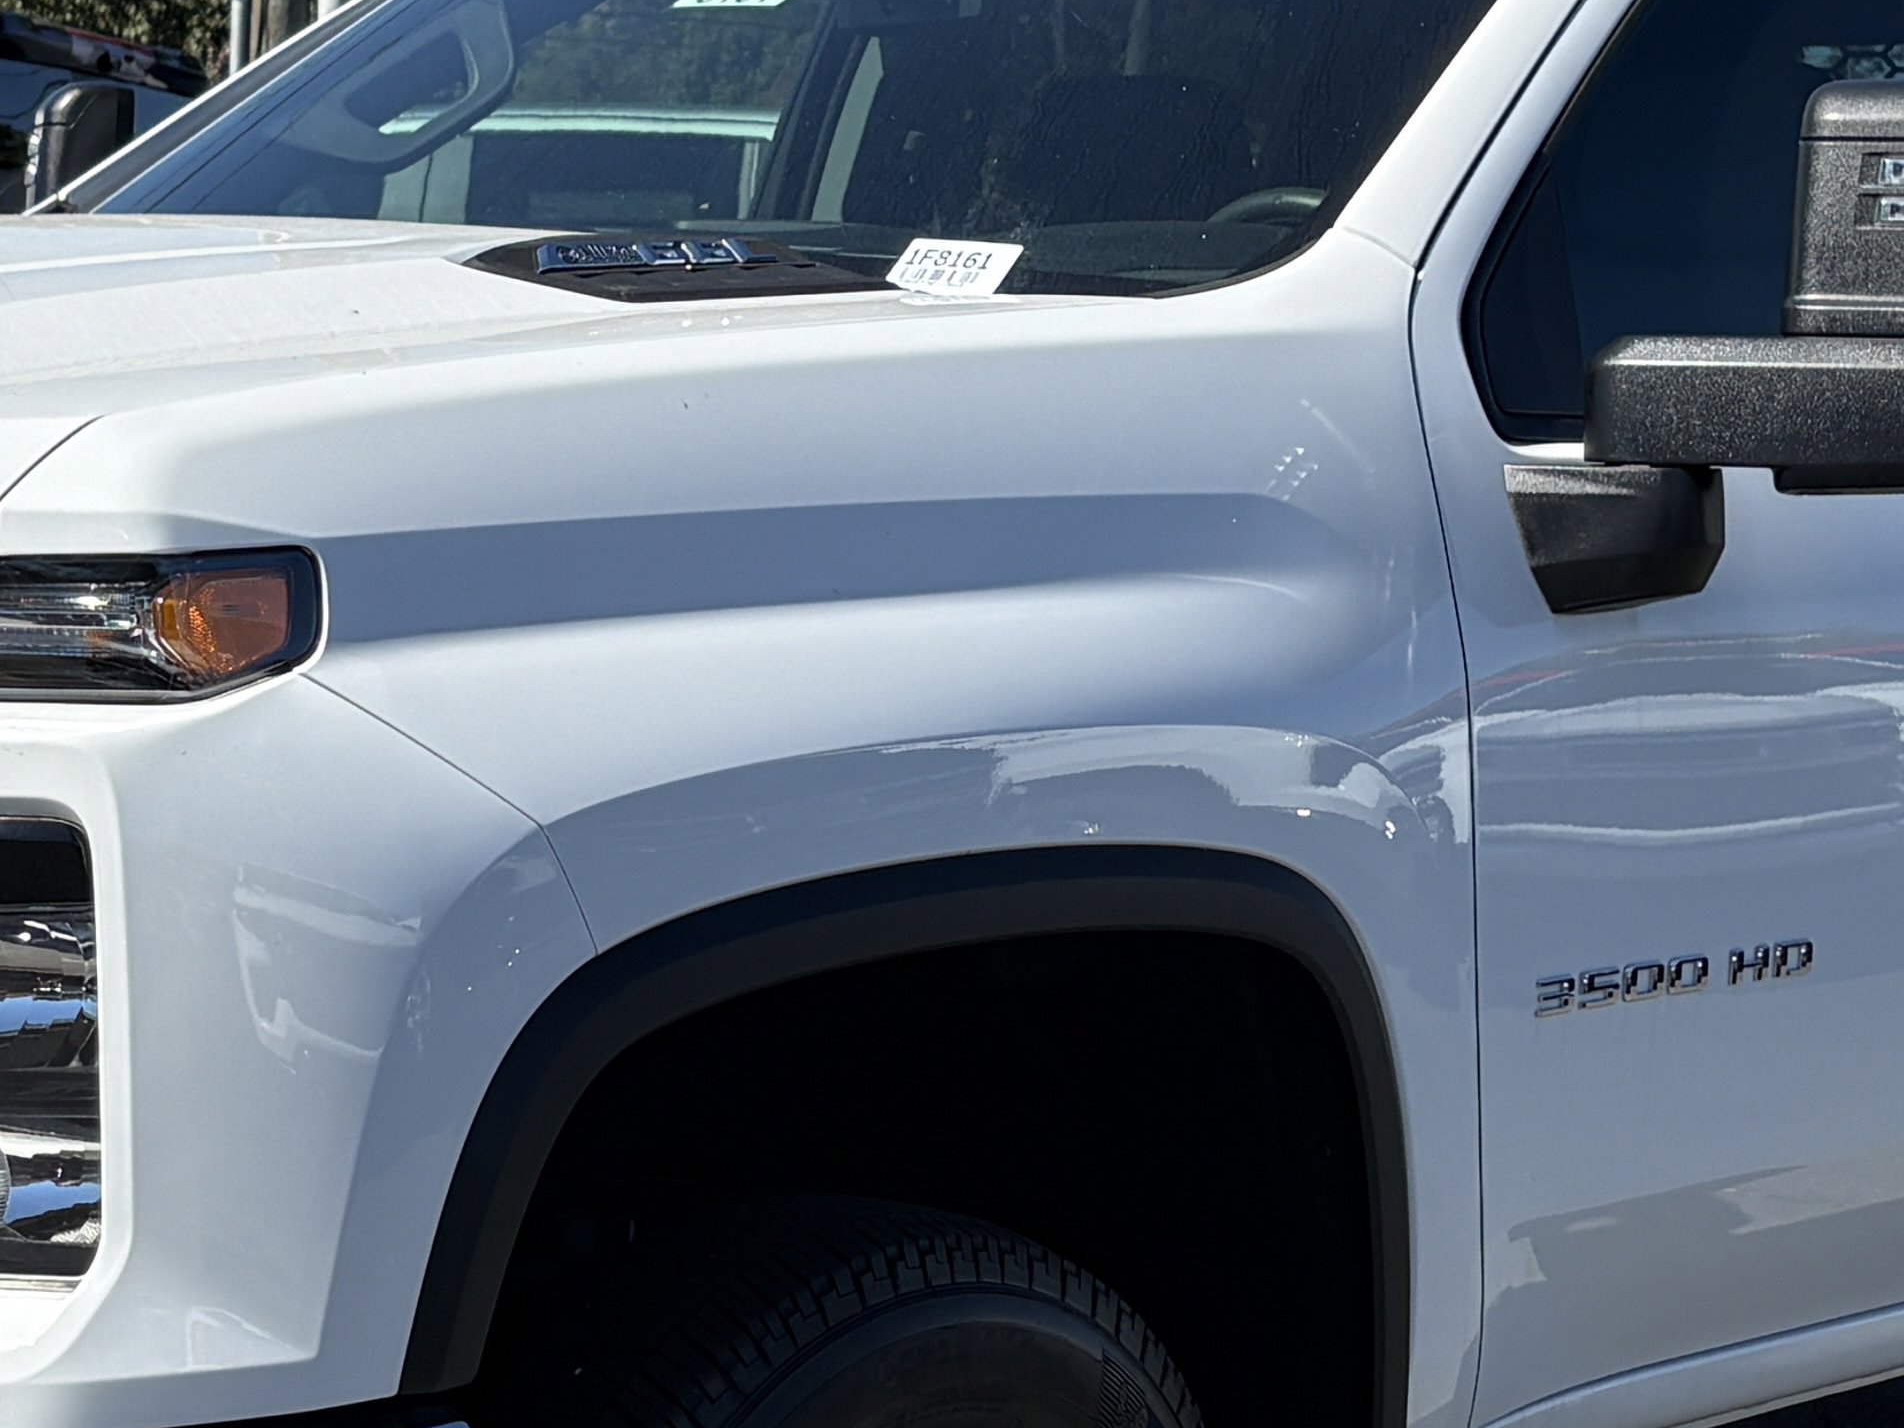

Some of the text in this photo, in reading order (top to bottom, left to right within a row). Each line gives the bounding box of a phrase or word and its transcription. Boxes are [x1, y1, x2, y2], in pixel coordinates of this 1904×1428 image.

[905, 248, 993, 270] 1F8161
[1534, 937, 1815, 1018] 3500 HD
